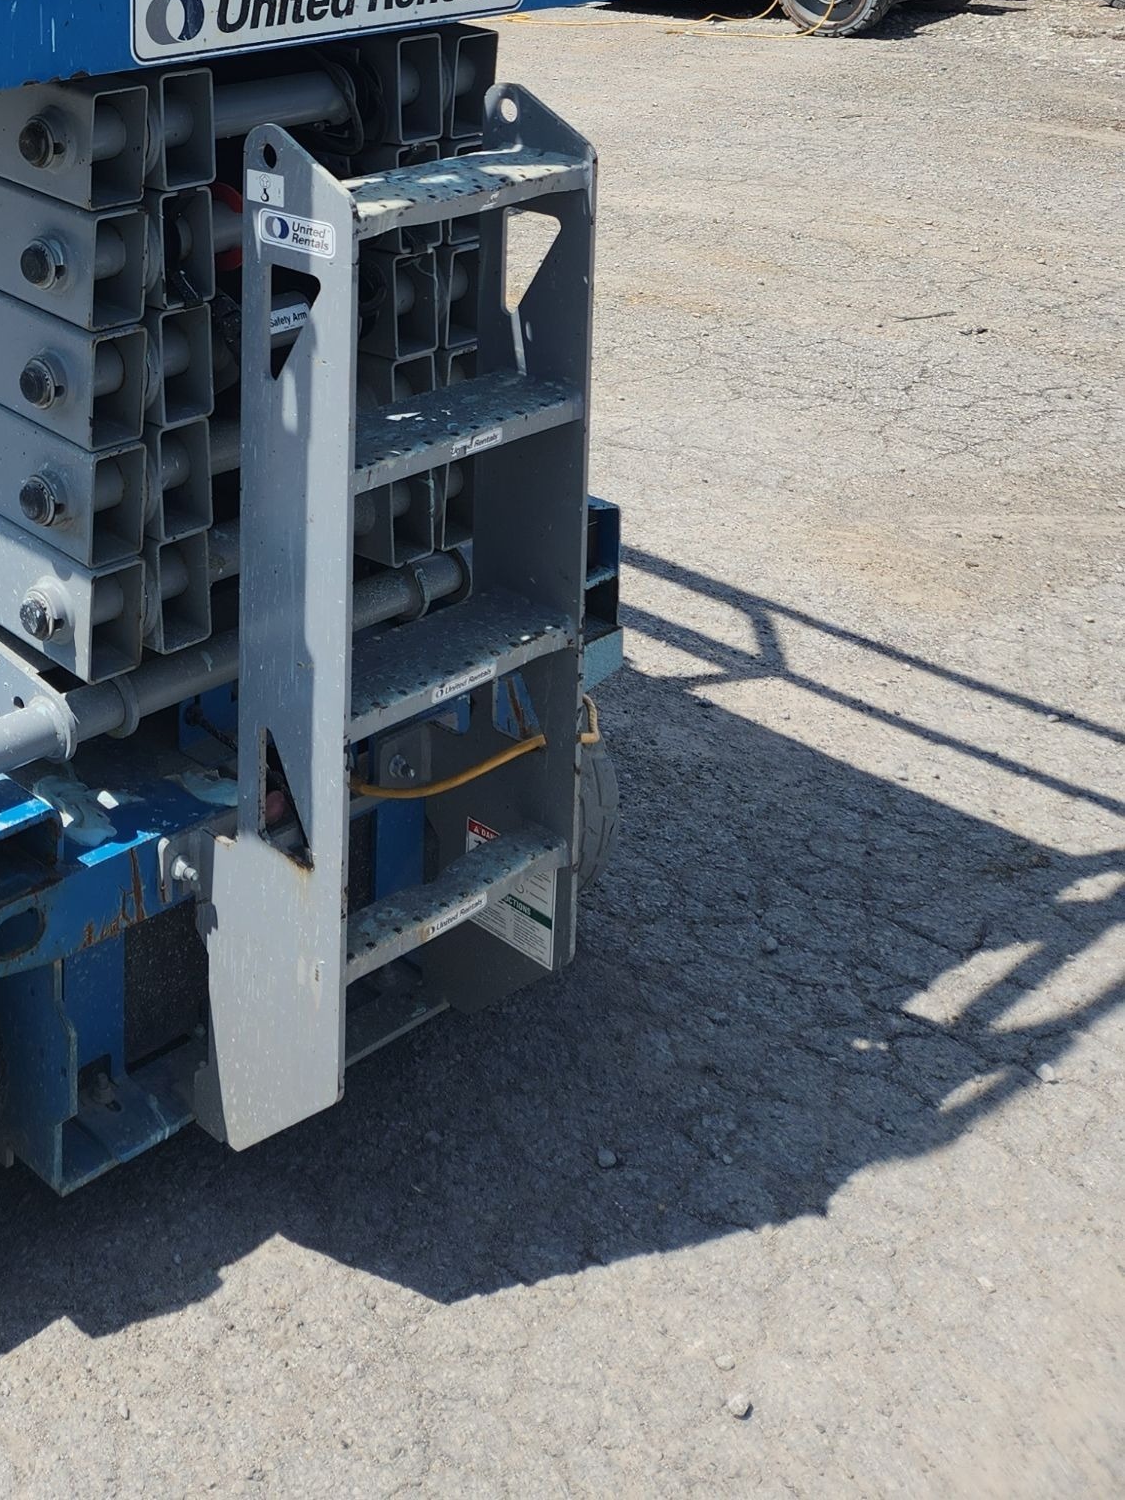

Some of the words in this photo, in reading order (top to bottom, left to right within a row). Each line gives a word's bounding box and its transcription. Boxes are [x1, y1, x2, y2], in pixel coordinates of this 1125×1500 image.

[292, 221, 326, 239] United
[292, 235, 329, 251] Rentals
[269, 313, 291, 328] Safety
[292, 311, 308, 322] Arm
